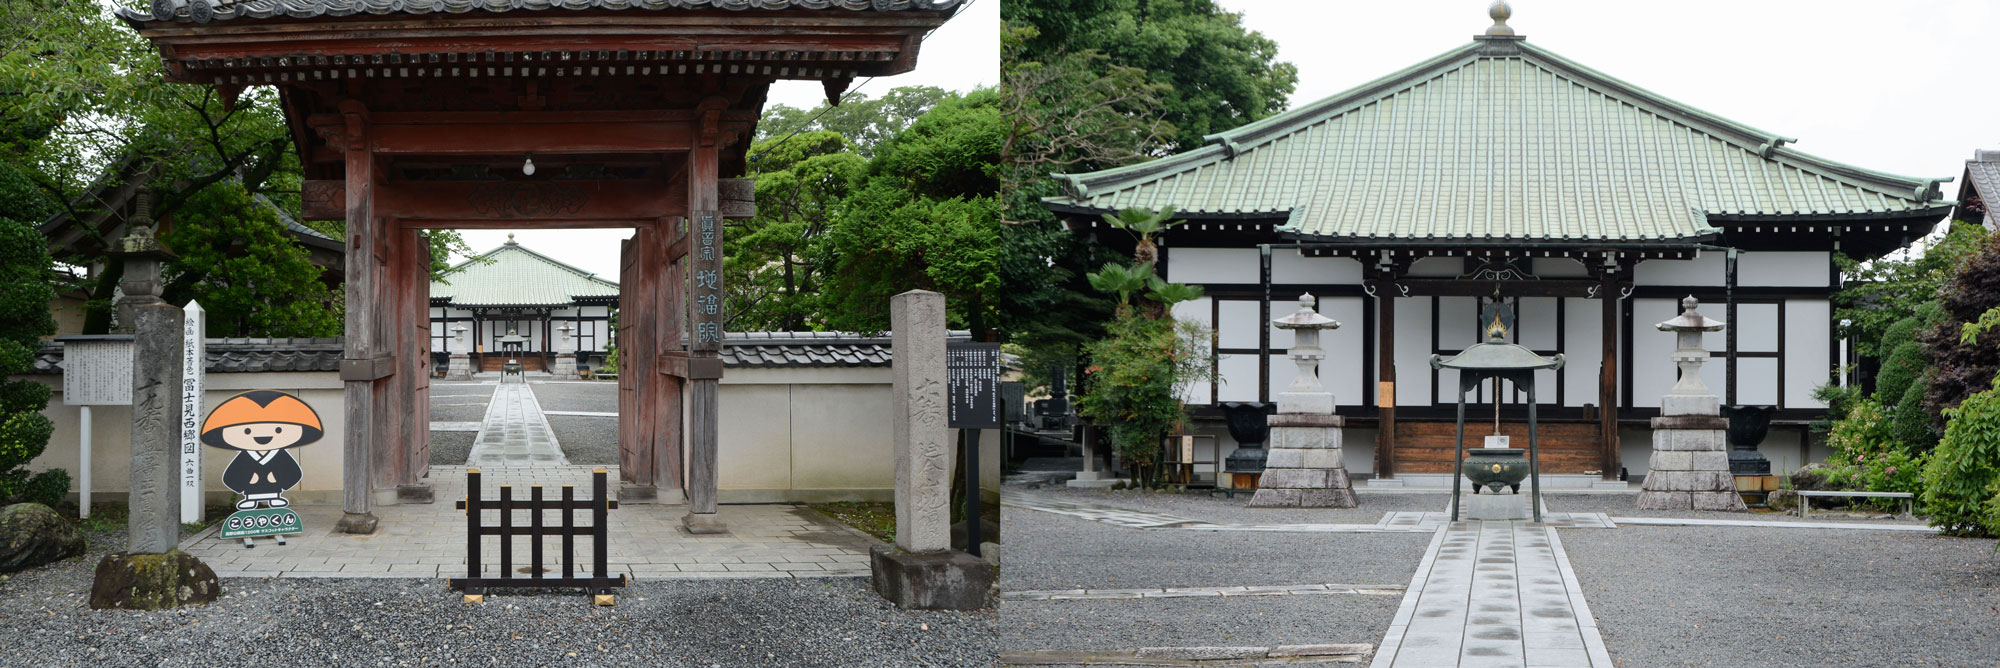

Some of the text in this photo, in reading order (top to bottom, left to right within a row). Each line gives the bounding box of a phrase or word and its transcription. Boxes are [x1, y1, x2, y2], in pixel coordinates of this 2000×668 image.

[696, 269, 720, 343] 地福院
[185, 317, 195, 336] 絵画
[230, 515, 294, 528] こうやくん
